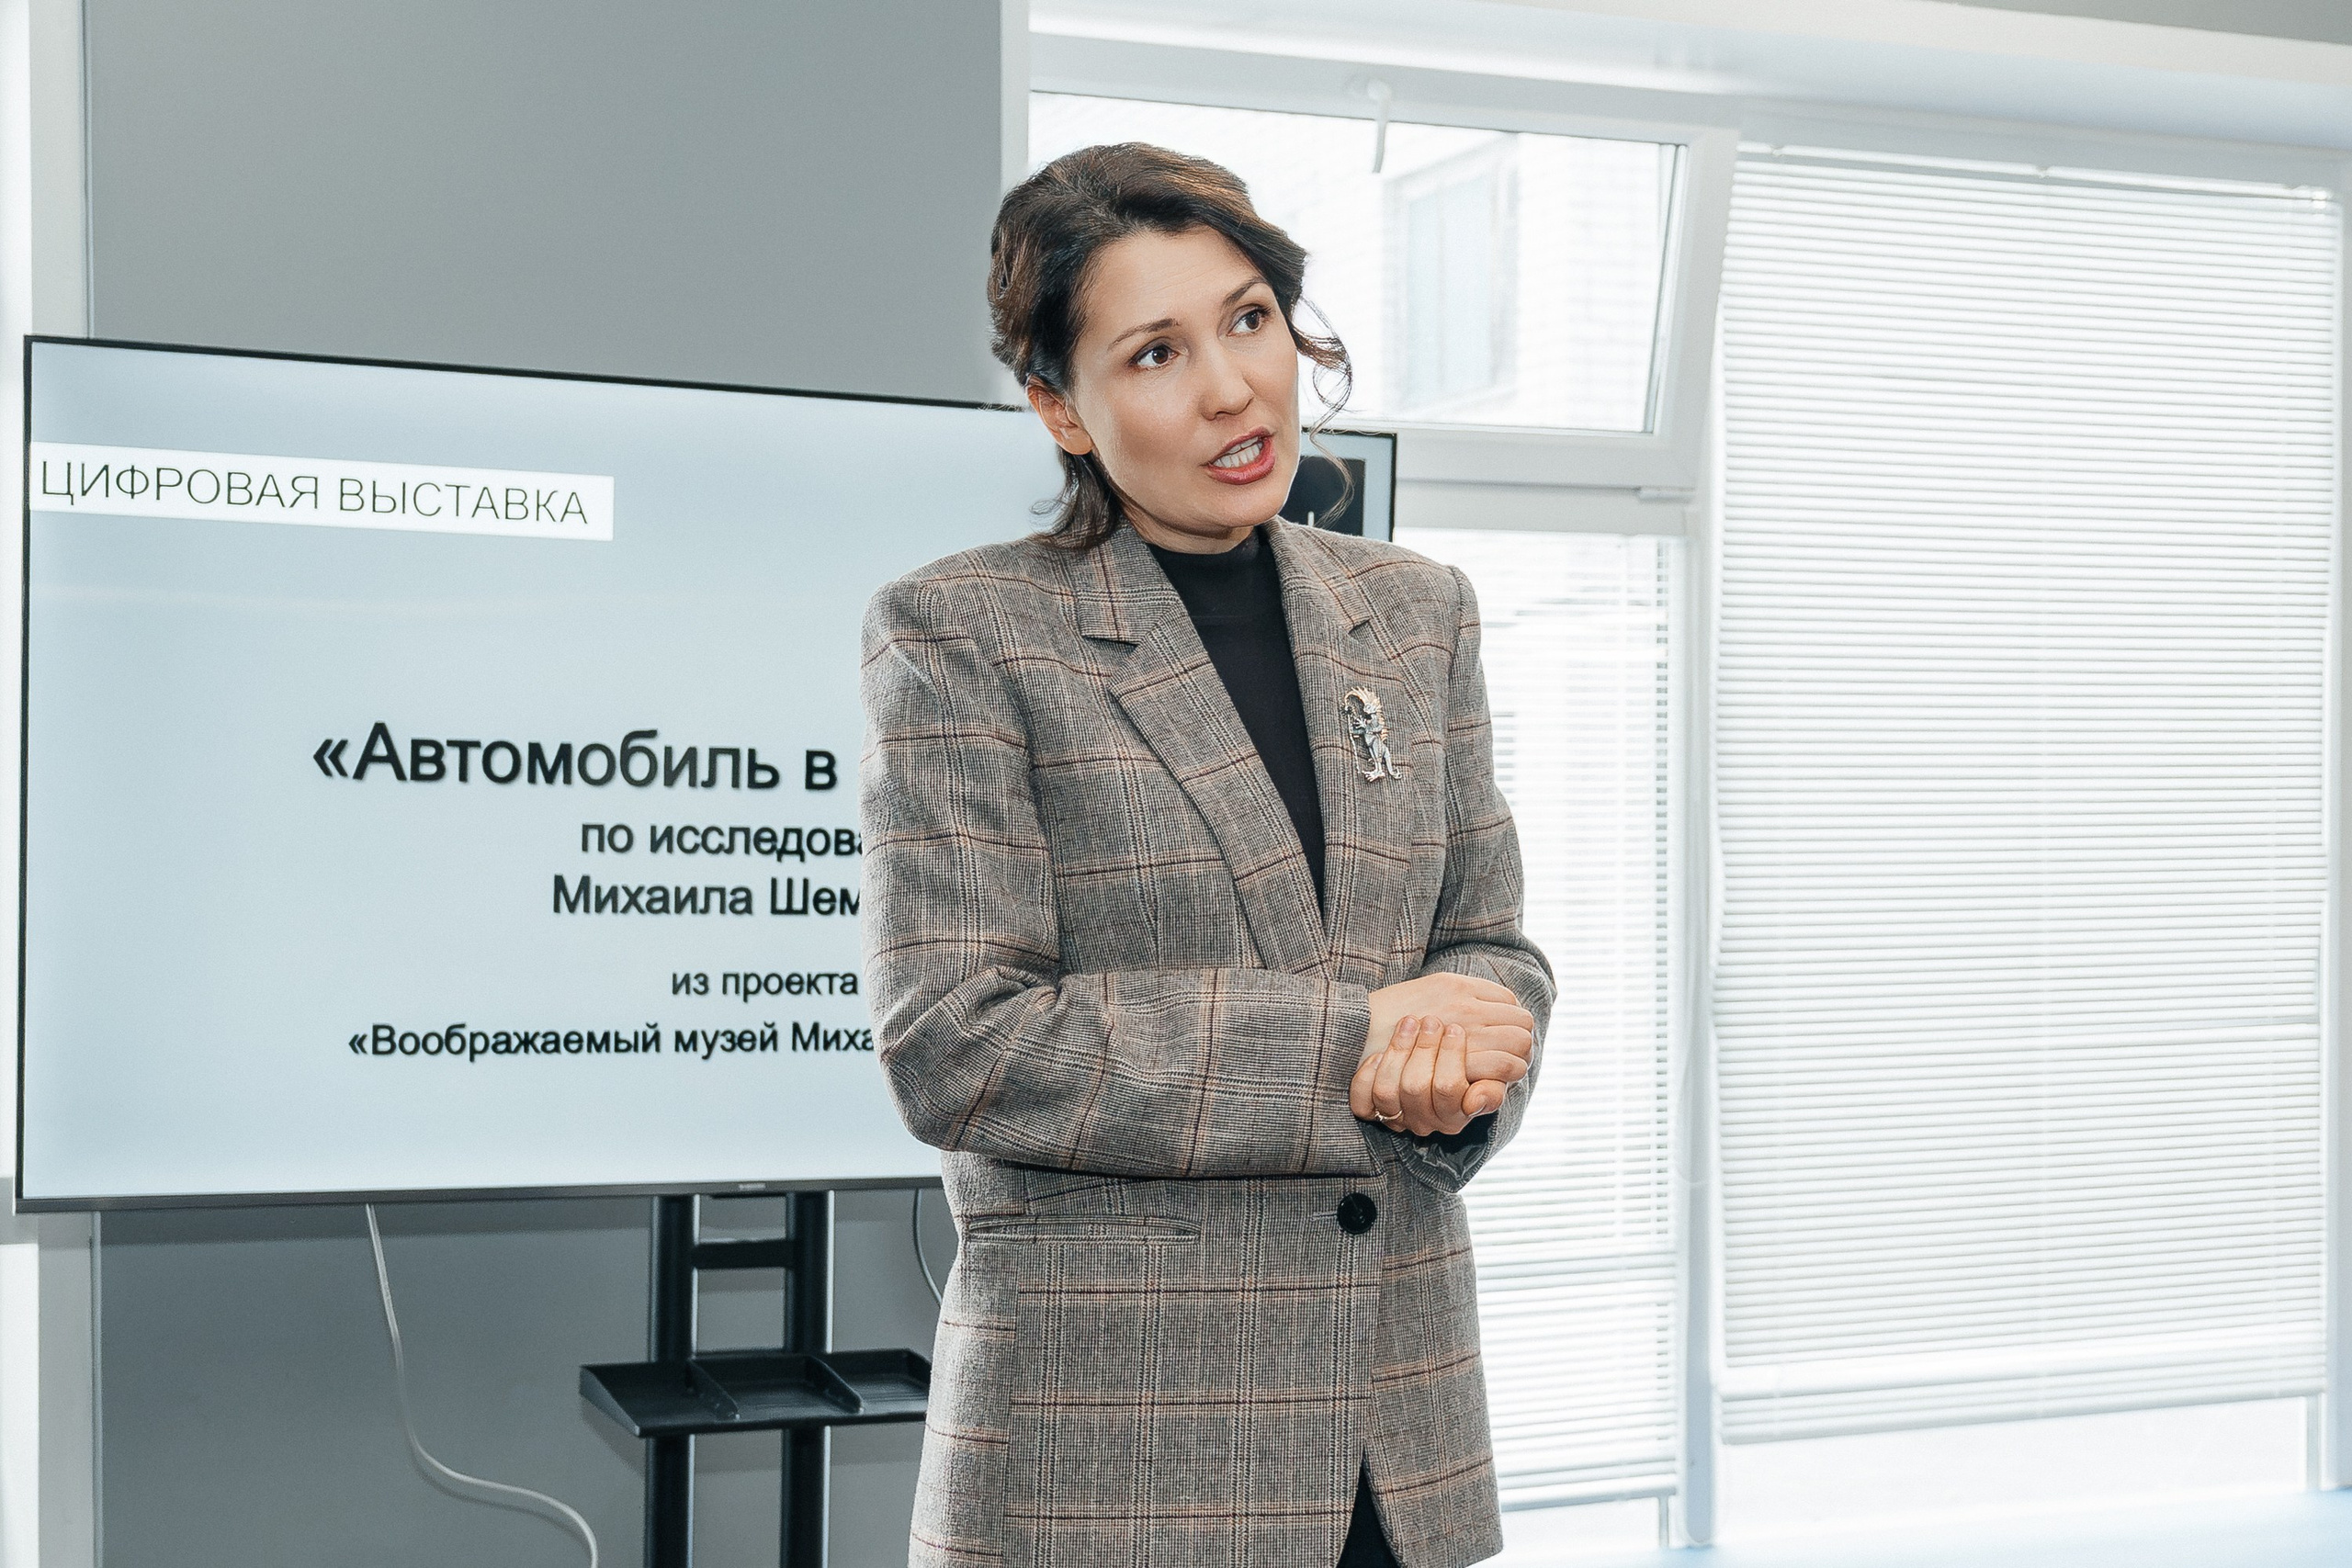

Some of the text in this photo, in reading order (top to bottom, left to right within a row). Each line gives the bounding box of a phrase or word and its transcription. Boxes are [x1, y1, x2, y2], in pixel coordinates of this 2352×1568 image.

[41, 460, 589, 525] ЦИФРОВАЯ ВЫСТАВКА
[312, 721, 839, 791] «Автомобиль в
[581, 823, 863, 863] по исследов
[553, 874, 753, 916] Михаила
[672, 971, 859, 1004] из проекта
[348, 1021, 662, 1064] «Воображаемый
[673, 1021, 779, 1061] музей
